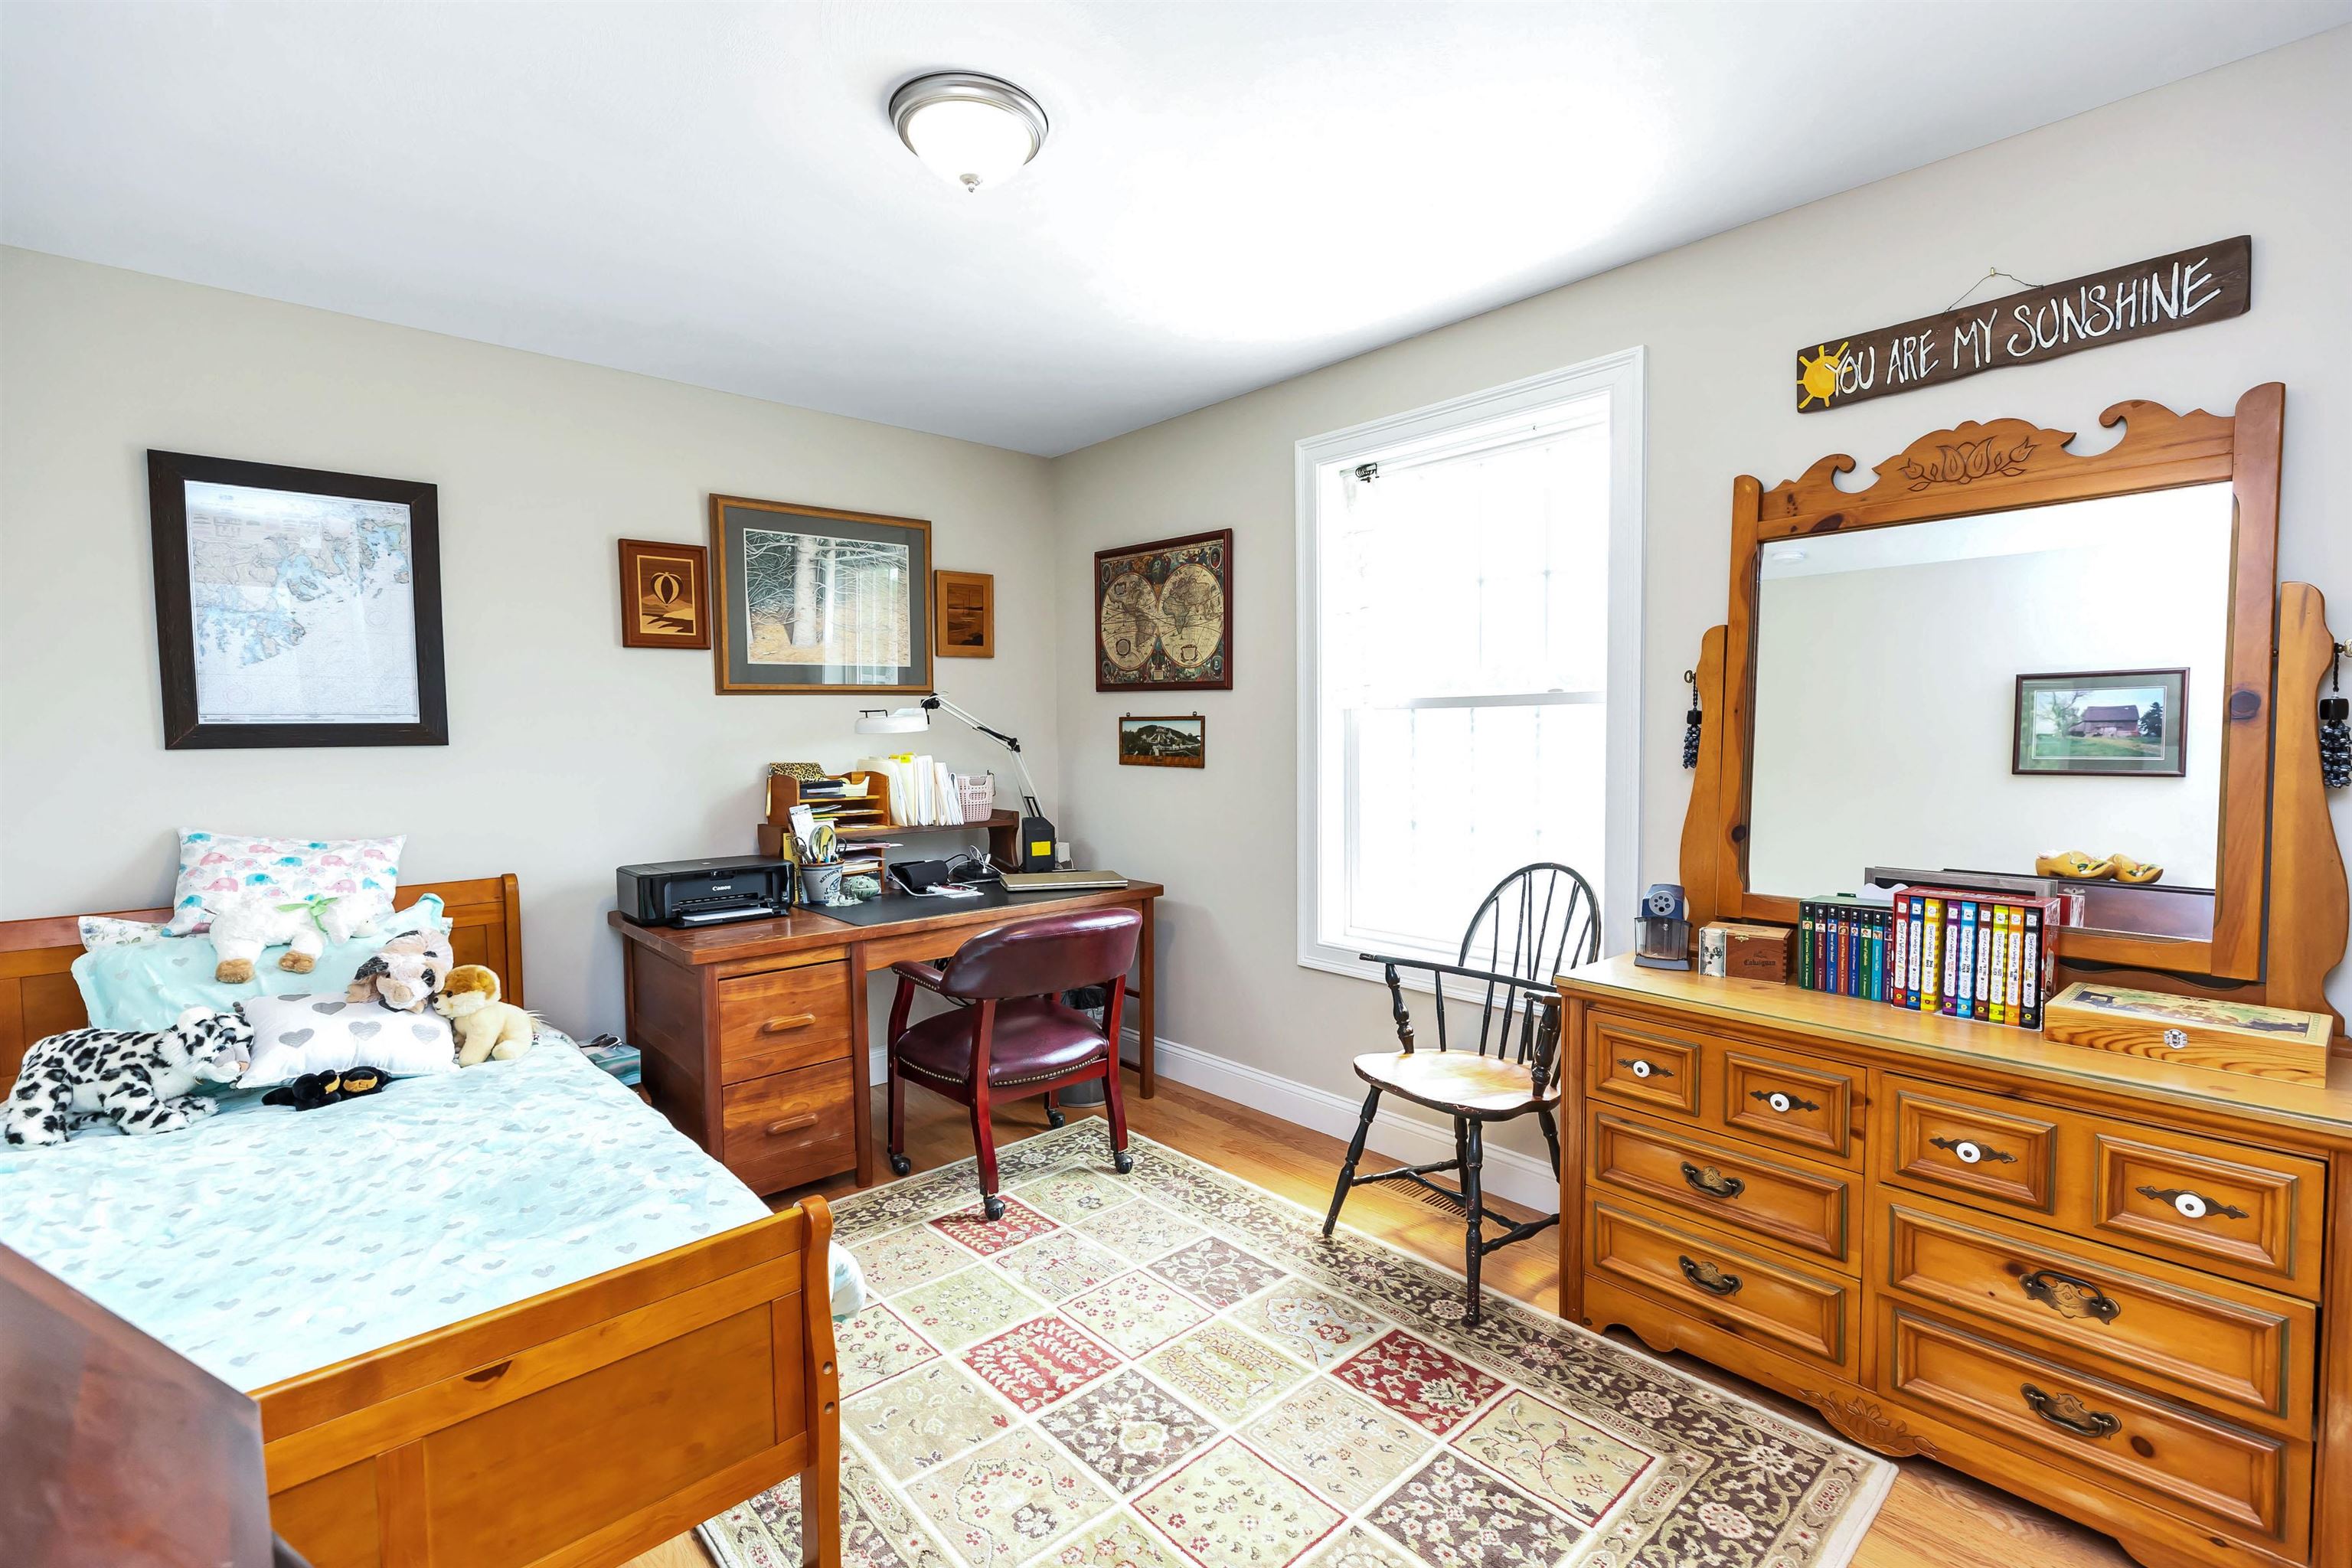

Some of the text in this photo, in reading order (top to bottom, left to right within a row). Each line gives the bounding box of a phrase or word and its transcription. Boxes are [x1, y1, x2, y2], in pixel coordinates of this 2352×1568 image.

[1825, 256, 2222, 397] YOU ARE MY SUNSHINE
